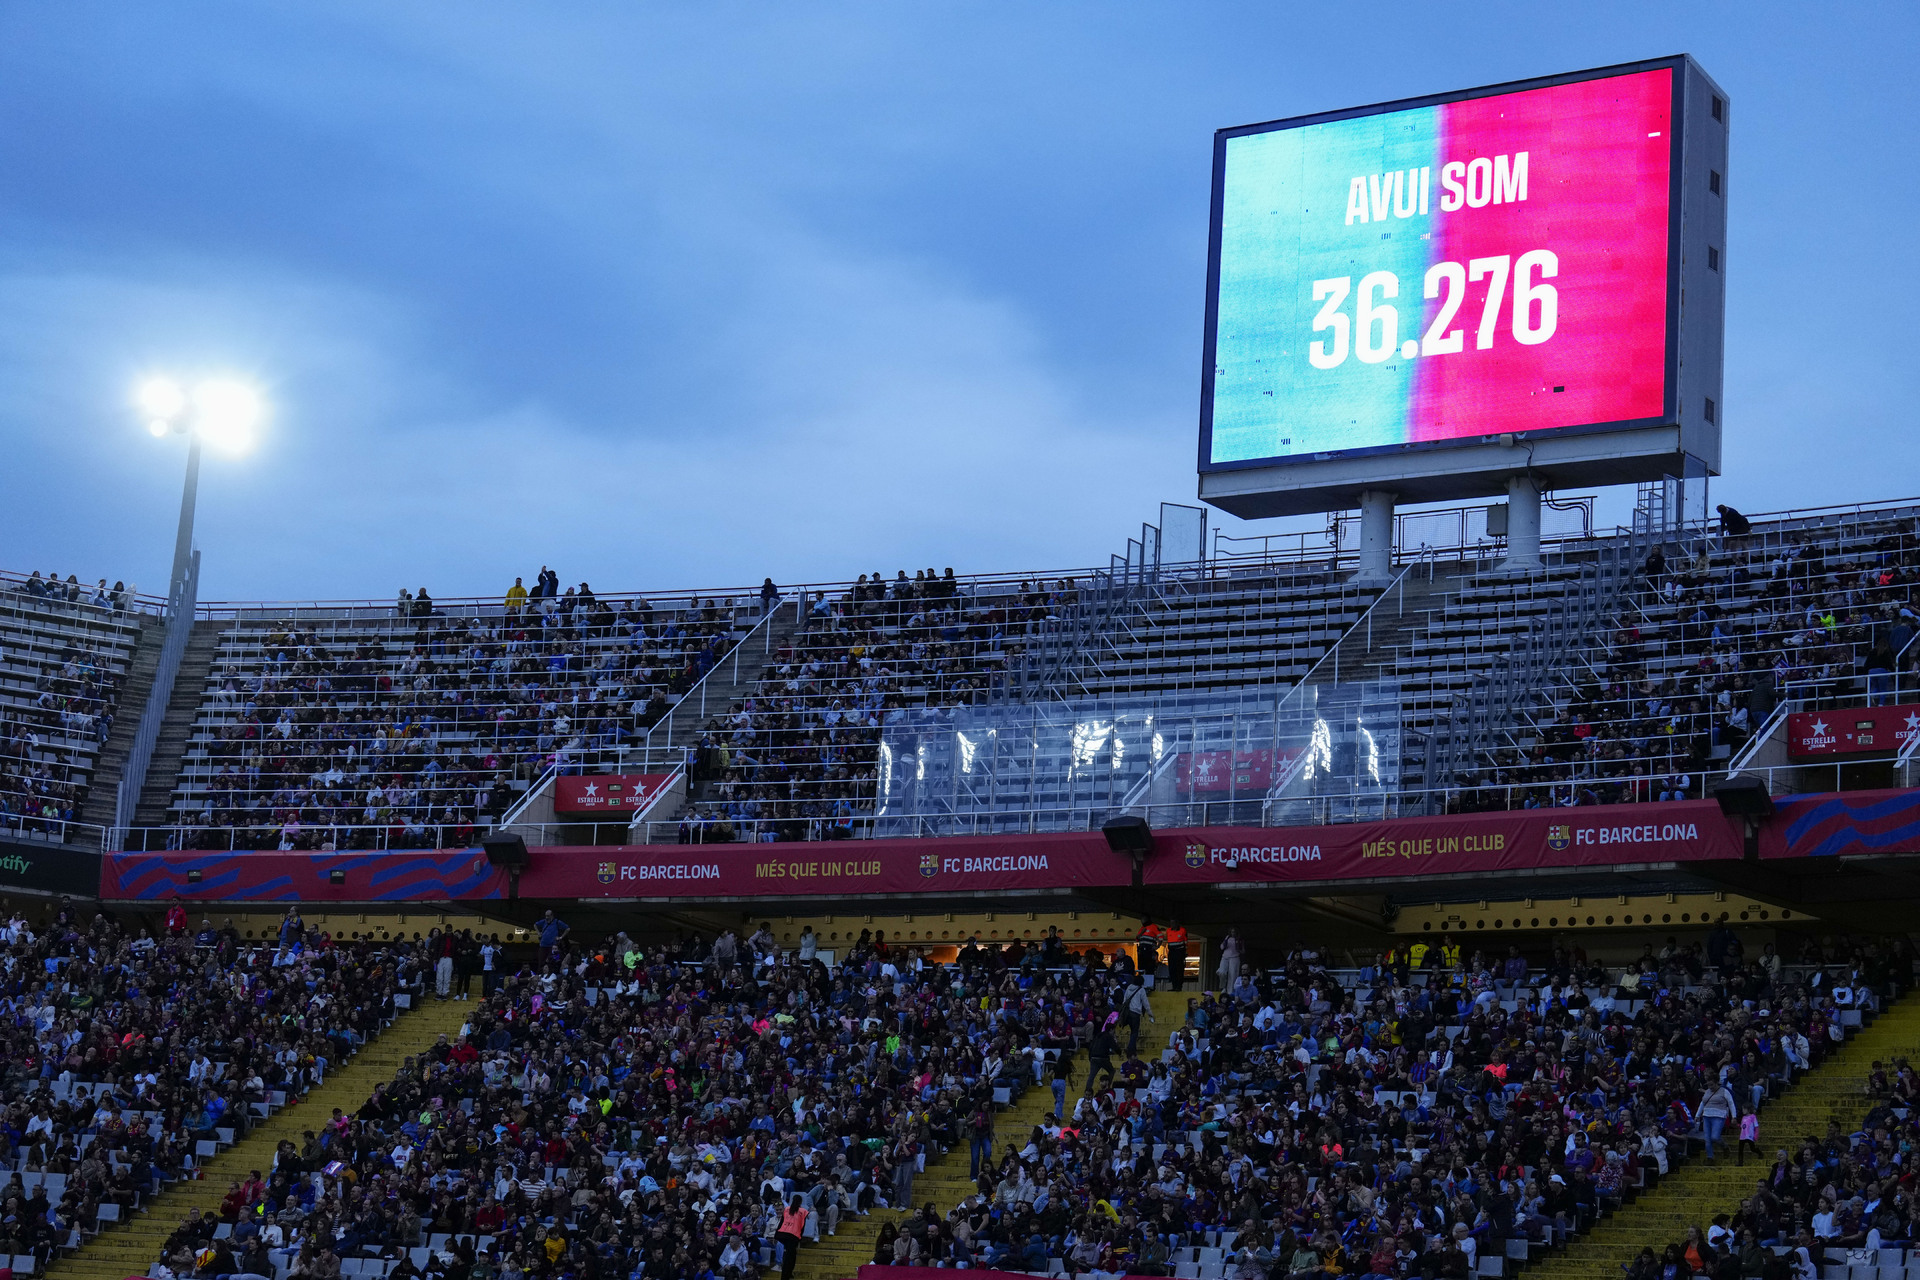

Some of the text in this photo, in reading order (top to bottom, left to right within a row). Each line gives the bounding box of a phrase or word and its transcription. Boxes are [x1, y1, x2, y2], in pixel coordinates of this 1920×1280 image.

[1345, 151, 1529, 225] AVUI SOM
[1309, 249, 1559, 369] 36.276
[1803, 736, 1836, 745] ESTRELLA
[1576, 823, 1698, 845] FC BARCELONA
[1211, 845, 1321, 863] FC BARCELONA
[1362, 834, 1505, 859] MÉS QUE UN CLUB
[621, 864, 720, 880] FC BARCELONA
[755, 859, 881, 879] MÉS QUE UN CLUB
[943, 855, 1049, 873] FC BARCELONA
